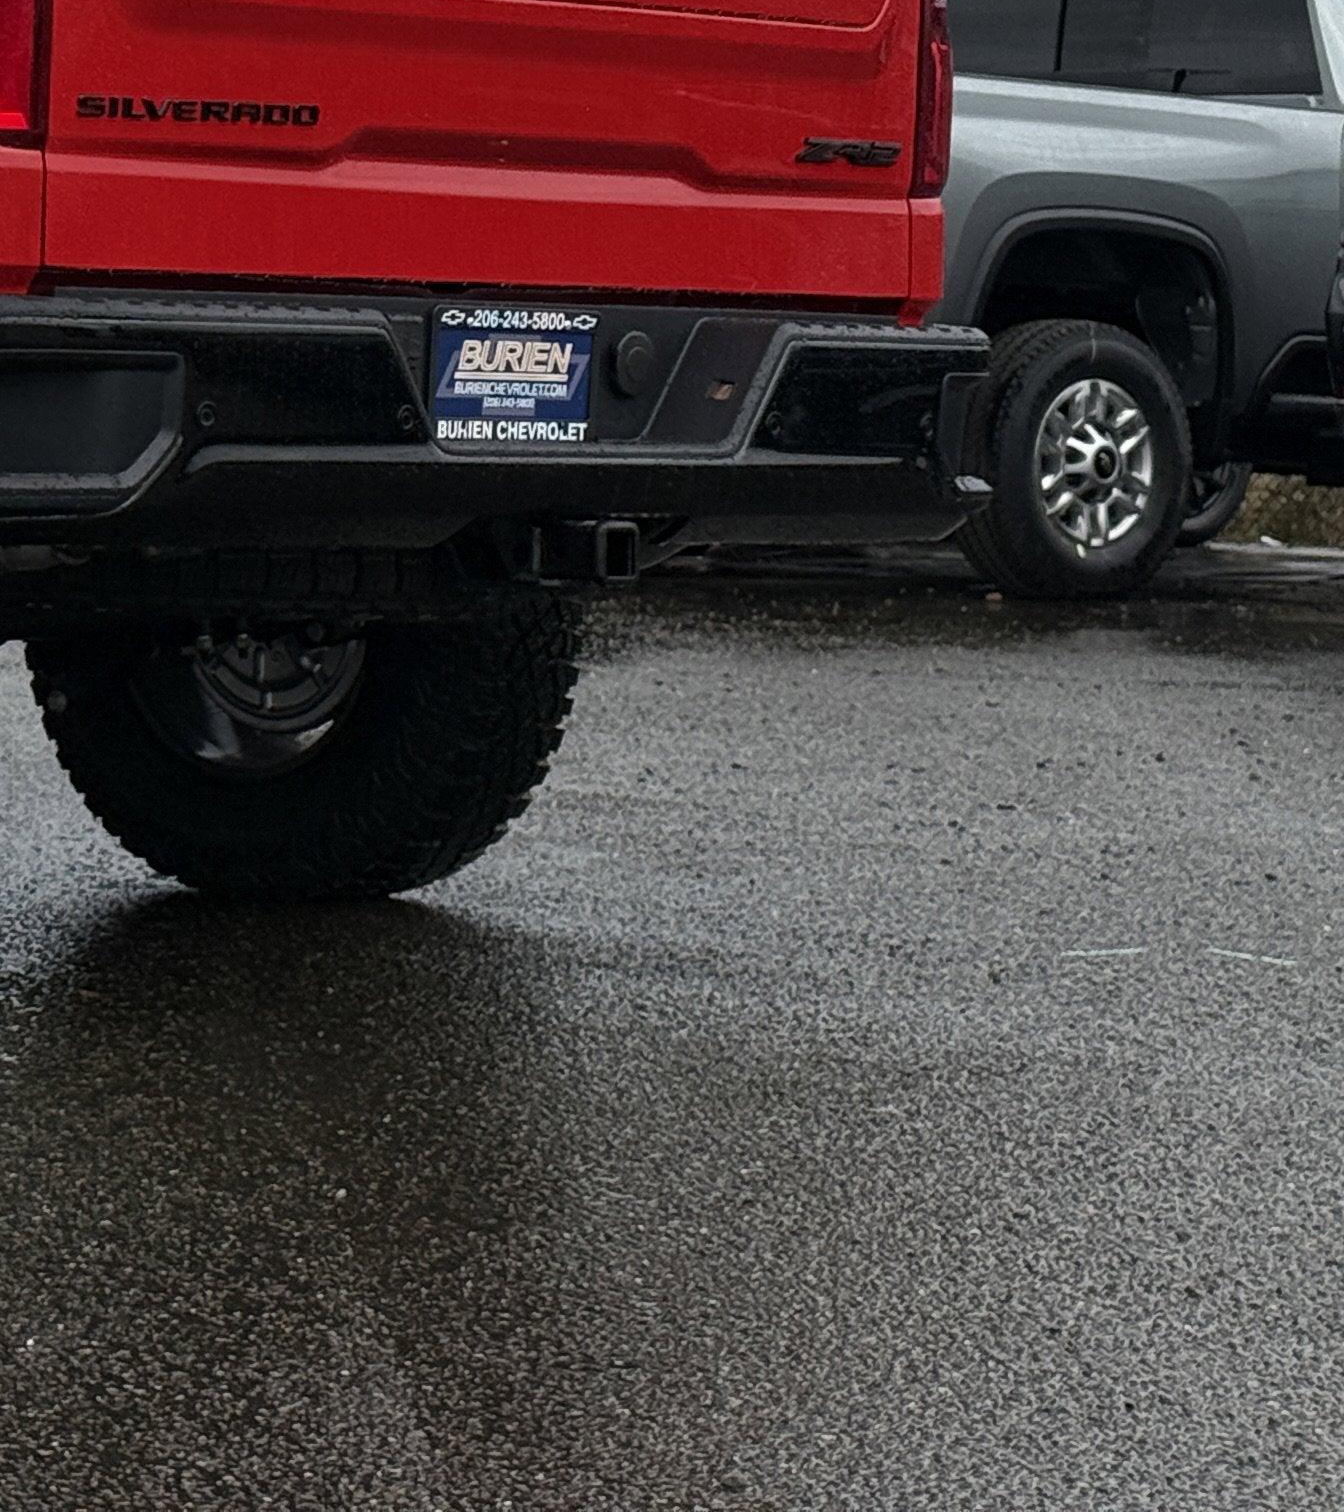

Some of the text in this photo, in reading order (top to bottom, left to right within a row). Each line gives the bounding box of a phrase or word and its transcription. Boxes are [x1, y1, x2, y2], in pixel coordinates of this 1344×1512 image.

[76, 94, 320, 126] SILVERADO
[458, 339, 573, 374] BURIEN
[437, 420, 588, 442] BURIEN CHEVROLET
